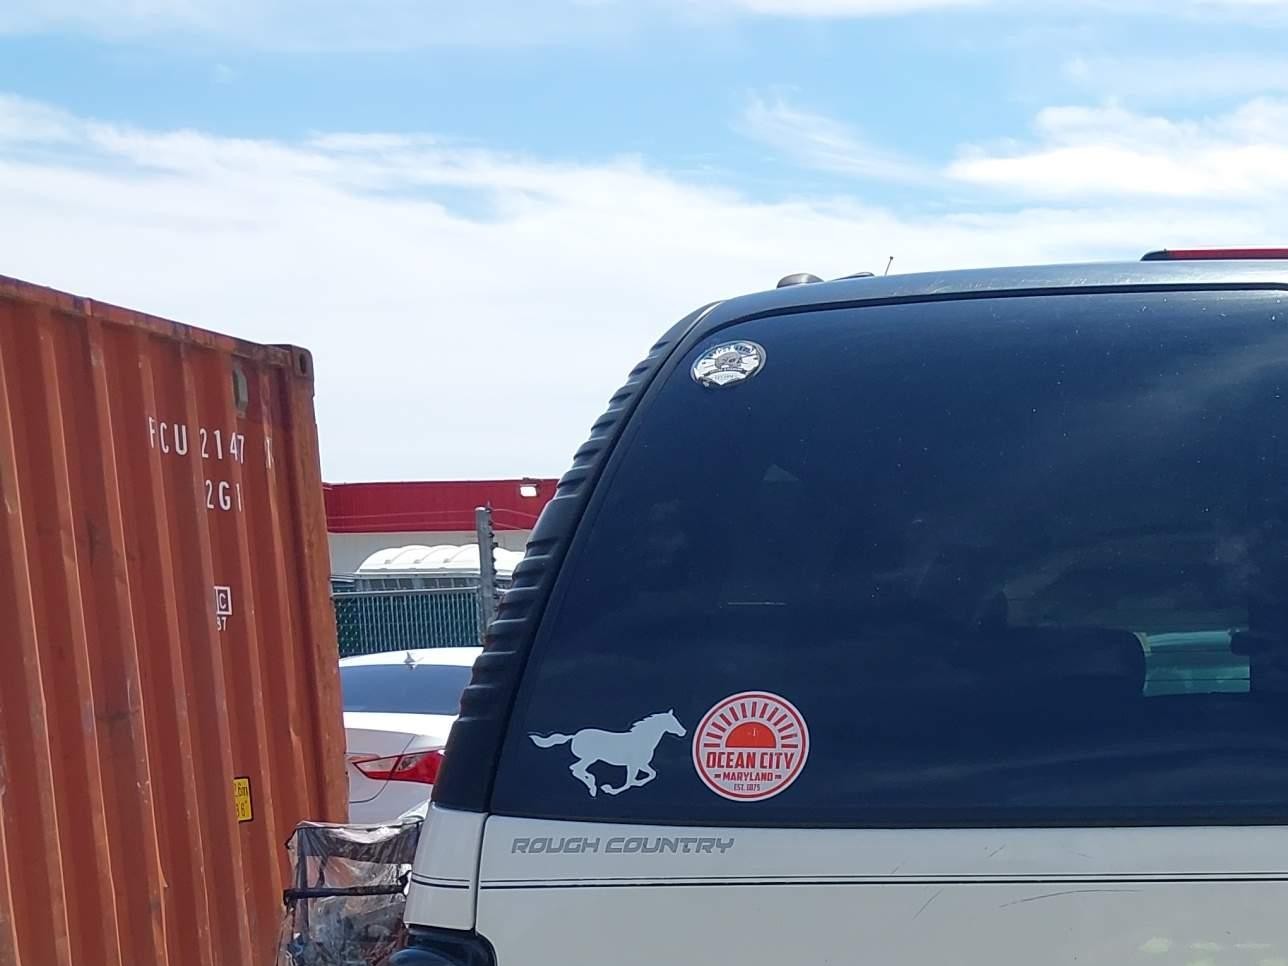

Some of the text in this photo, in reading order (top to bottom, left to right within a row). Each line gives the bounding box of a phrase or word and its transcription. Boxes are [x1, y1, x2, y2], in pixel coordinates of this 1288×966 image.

[706, 751, 795, 770] OCEAN CITY
[723, 771, 774, 782] MARYLAND
[511, 837, 735, 854] ROUGH COUNTRY
